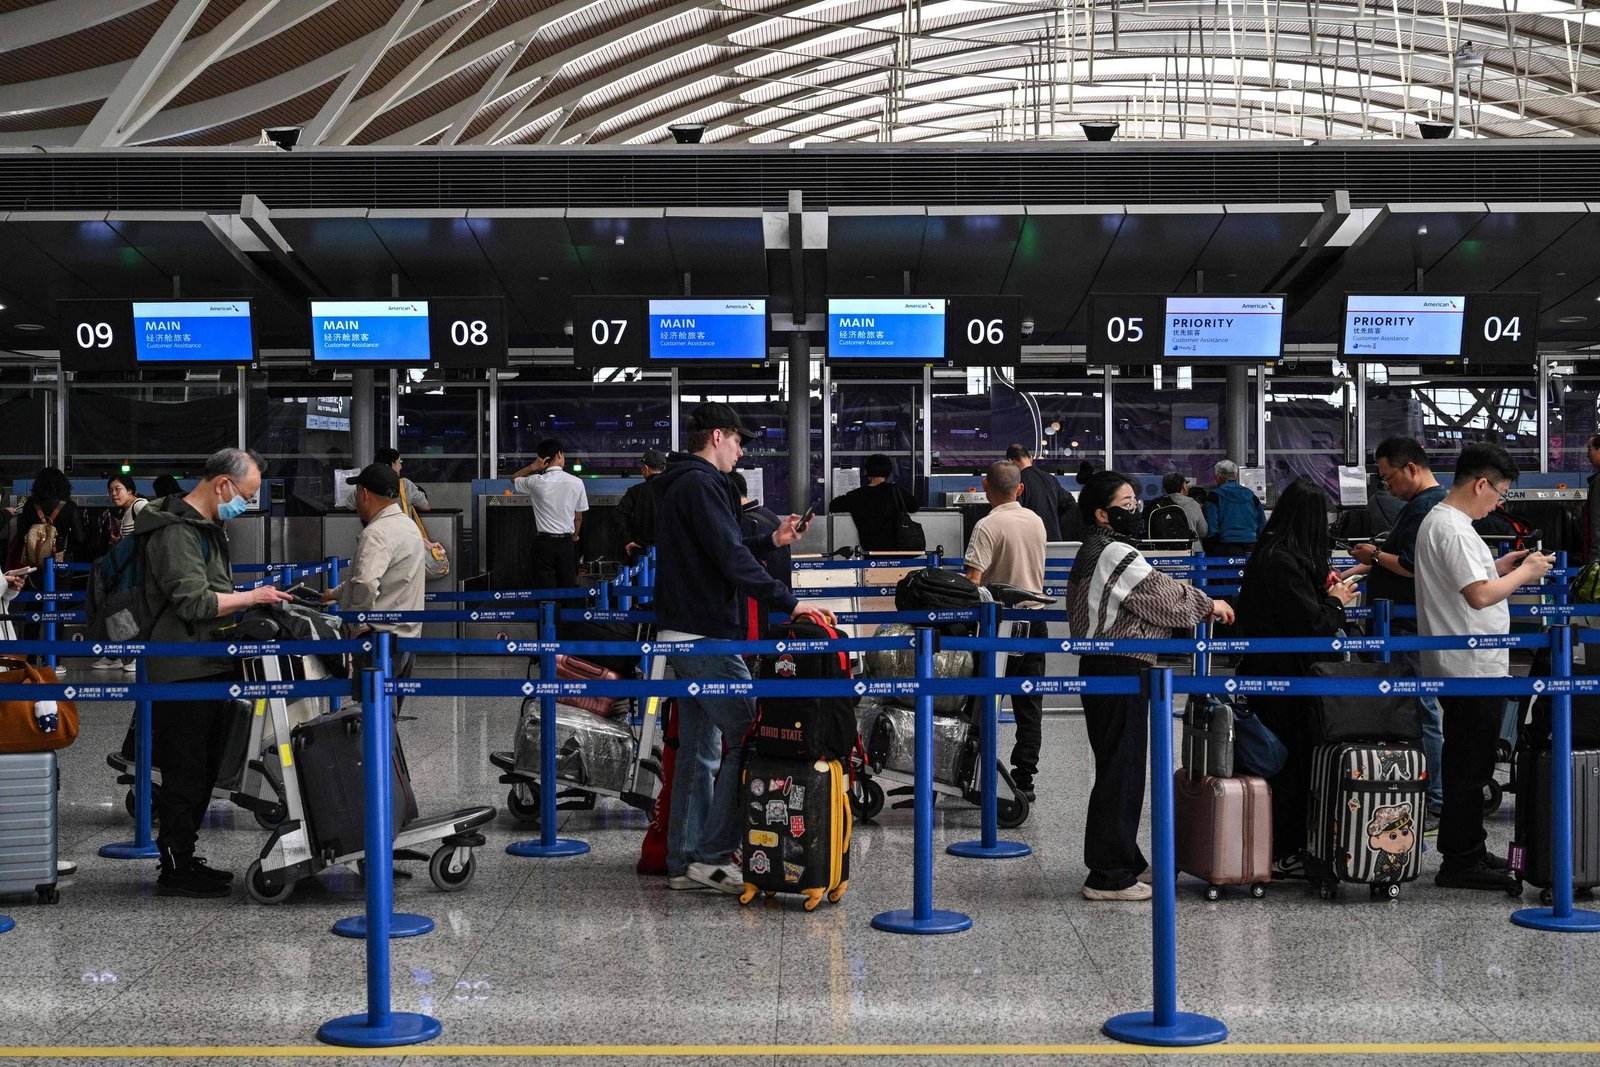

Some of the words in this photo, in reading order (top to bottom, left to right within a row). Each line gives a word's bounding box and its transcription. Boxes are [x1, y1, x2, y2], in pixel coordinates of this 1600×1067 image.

[146, 321, 180, 330] MAIN
[324, 320, 359, 330] MAIN
[660, 319, 695, 328] MAIN
[840, 318, 874, 327] MAIN
[1173, 319, 1234, 327] PRIORITY
[1354, 317, 1414, 326] PRIORITY
[451, 320, 488, 346] 08
[592, 320, 627, 344] 07
[968, 319, 1003, 344] 06
[1107, 317, 1143, 342] 05
[1484, 316, 1521, 341] 04
[76, 323, 113, 348] 09
[146, 334, 191, 342] 经济舱旅客
[760, 726, 778, 739] OHIO
[781, 728, 802, 741] STATE
